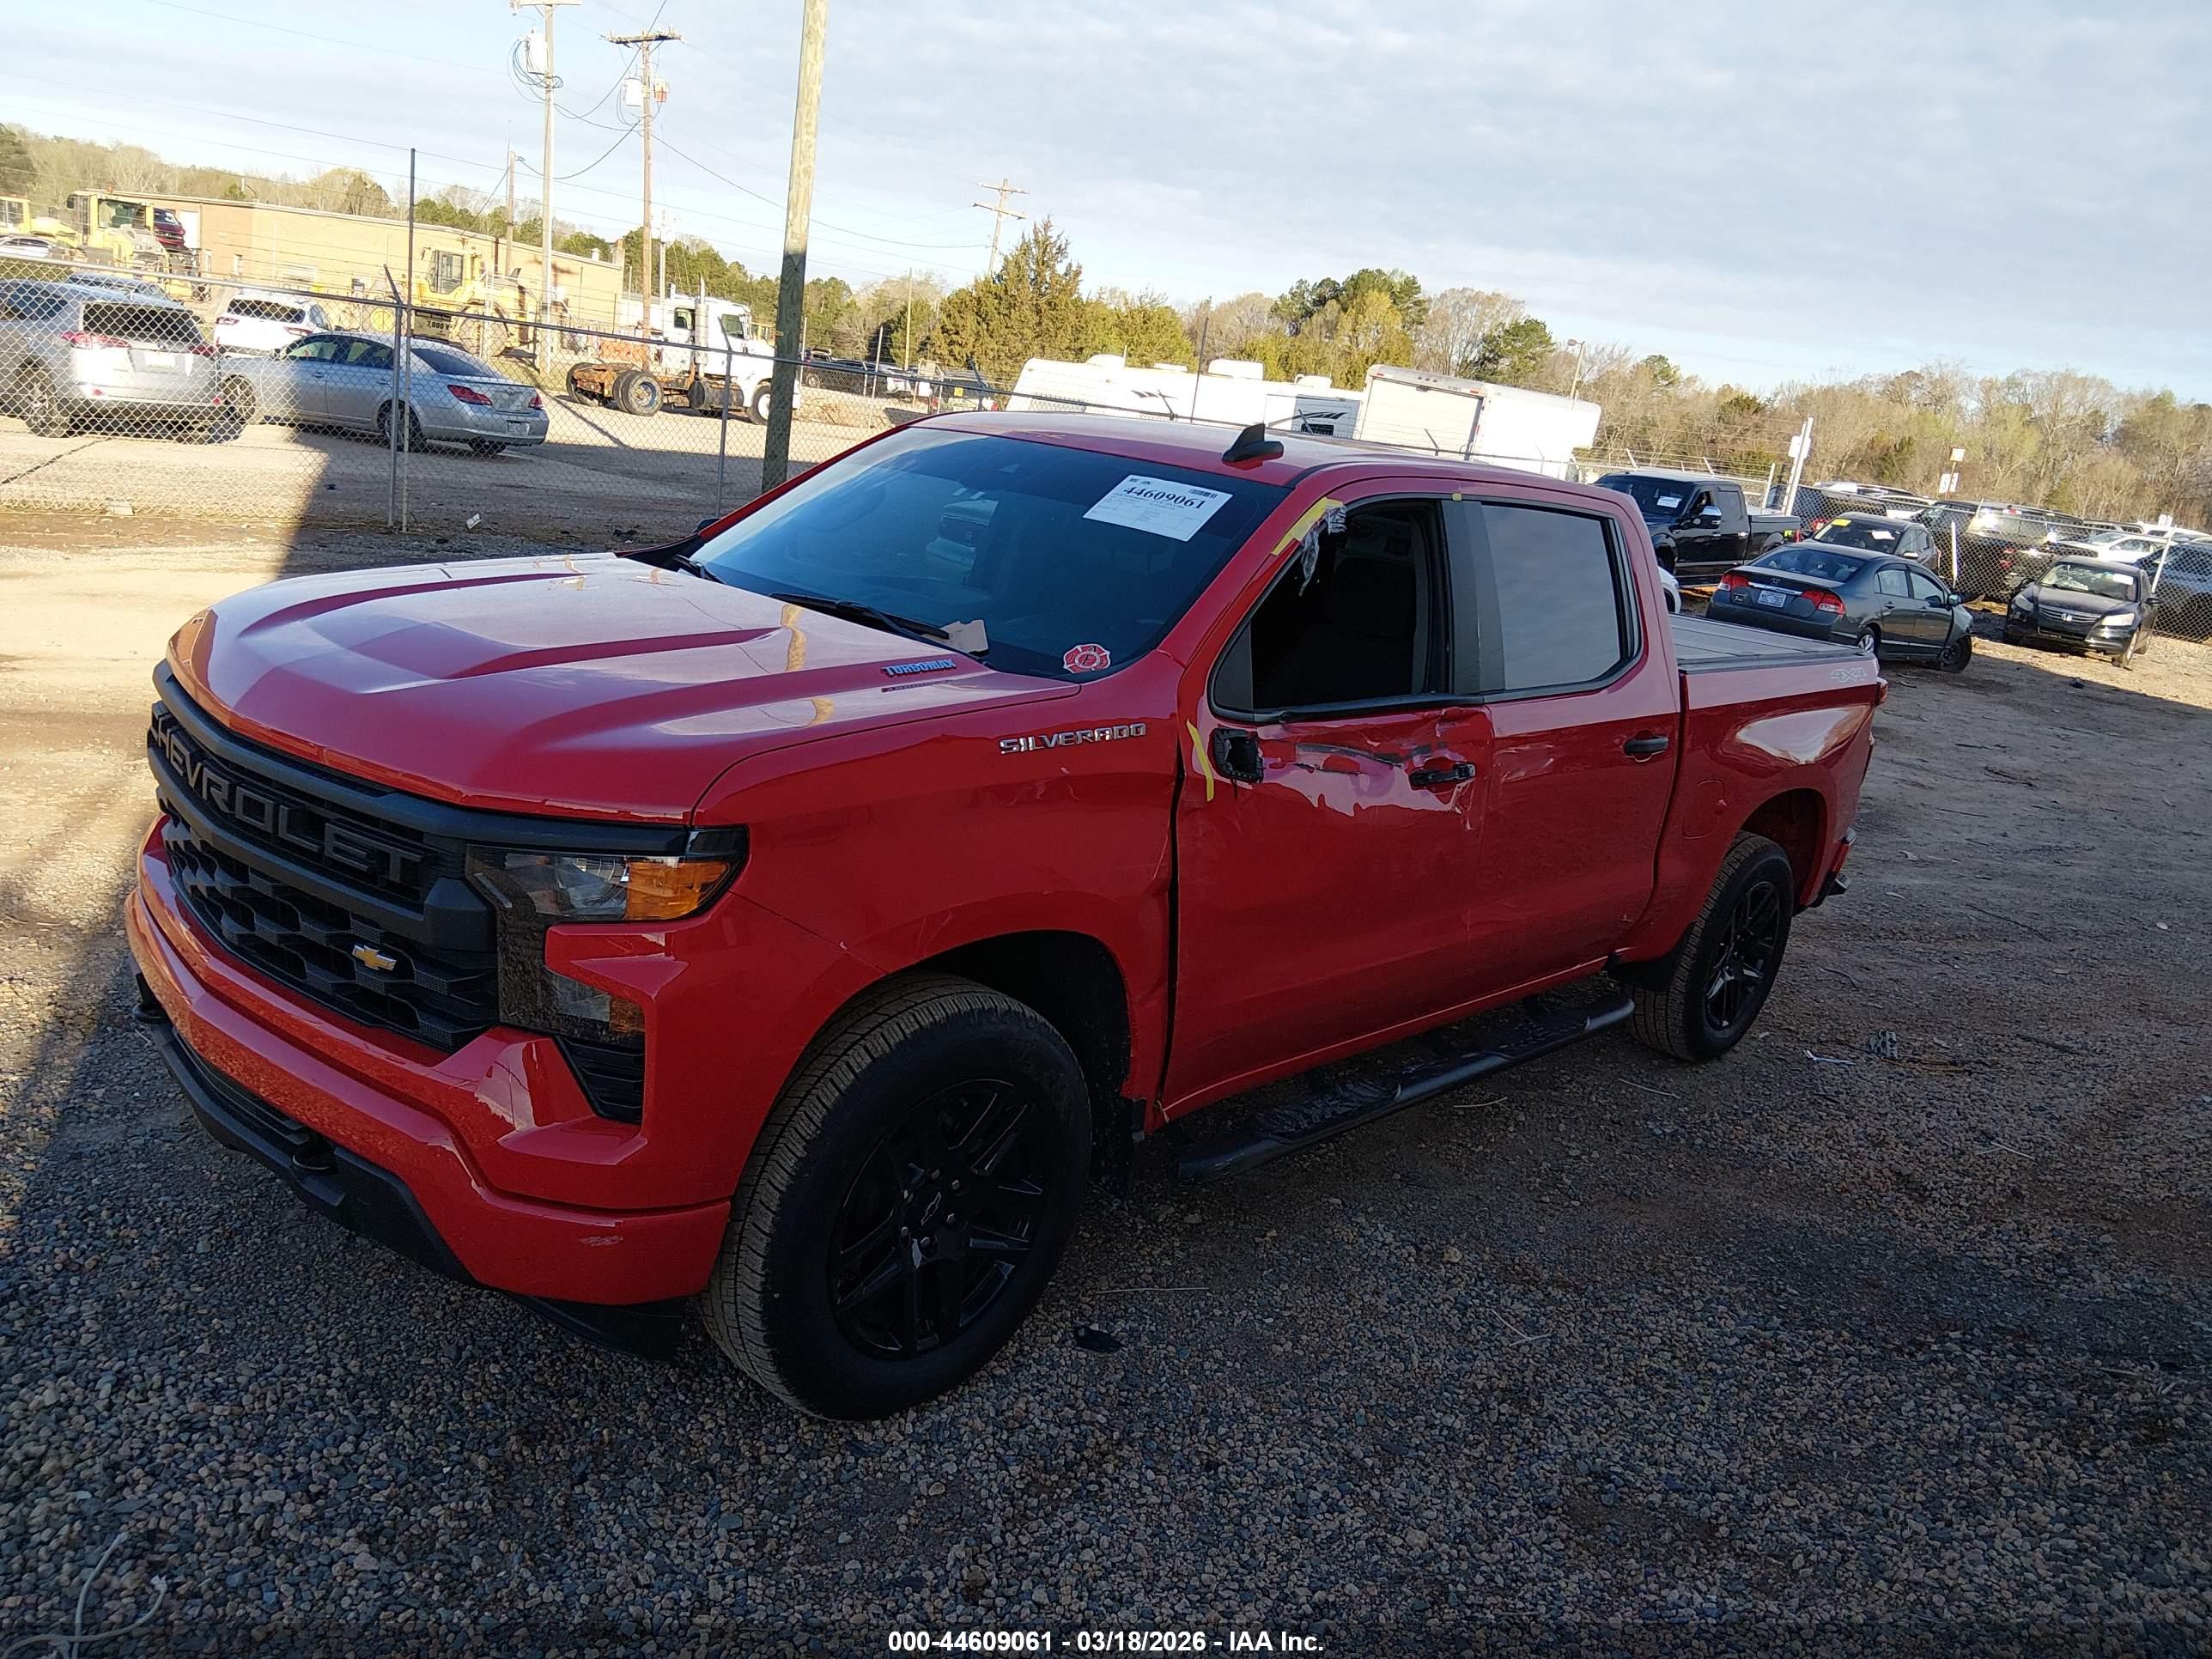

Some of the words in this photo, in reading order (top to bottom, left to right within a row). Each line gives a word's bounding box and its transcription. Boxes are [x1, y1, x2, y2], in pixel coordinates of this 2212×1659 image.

[1123, 486, 1207, 509] 44609061
[881, 659, 957, 677] TURBOMAX
[1000, 722, 1146, 755] SILVERADO
